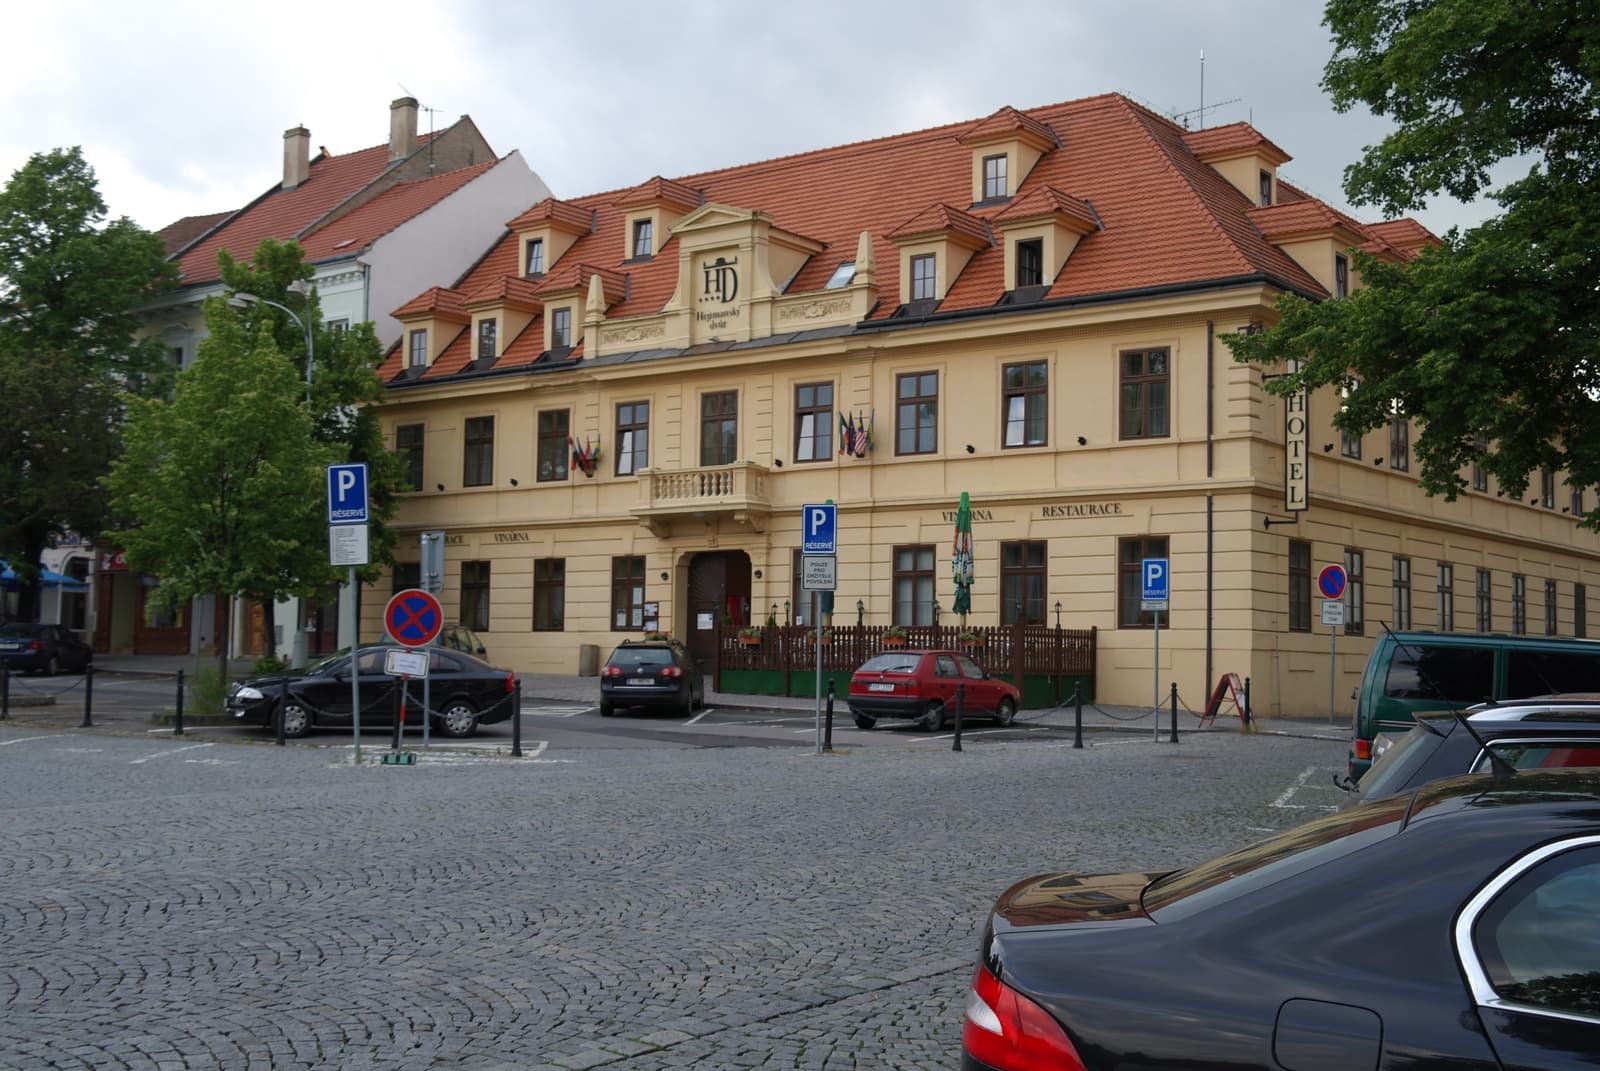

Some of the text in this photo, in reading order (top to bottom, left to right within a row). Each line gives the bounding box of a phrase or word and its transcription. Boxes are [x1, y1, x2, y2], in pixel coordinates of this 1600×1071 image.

[1288, 393, 1305, 503] HOTEL
[338, 470, 356, 502] P
[811, 508, 827, 536] P
[942, 509, 993, 523] VINRNA
[1042, 502, 1122, 518] RESTAURACE
[1147, 564, 1163, 588] P
